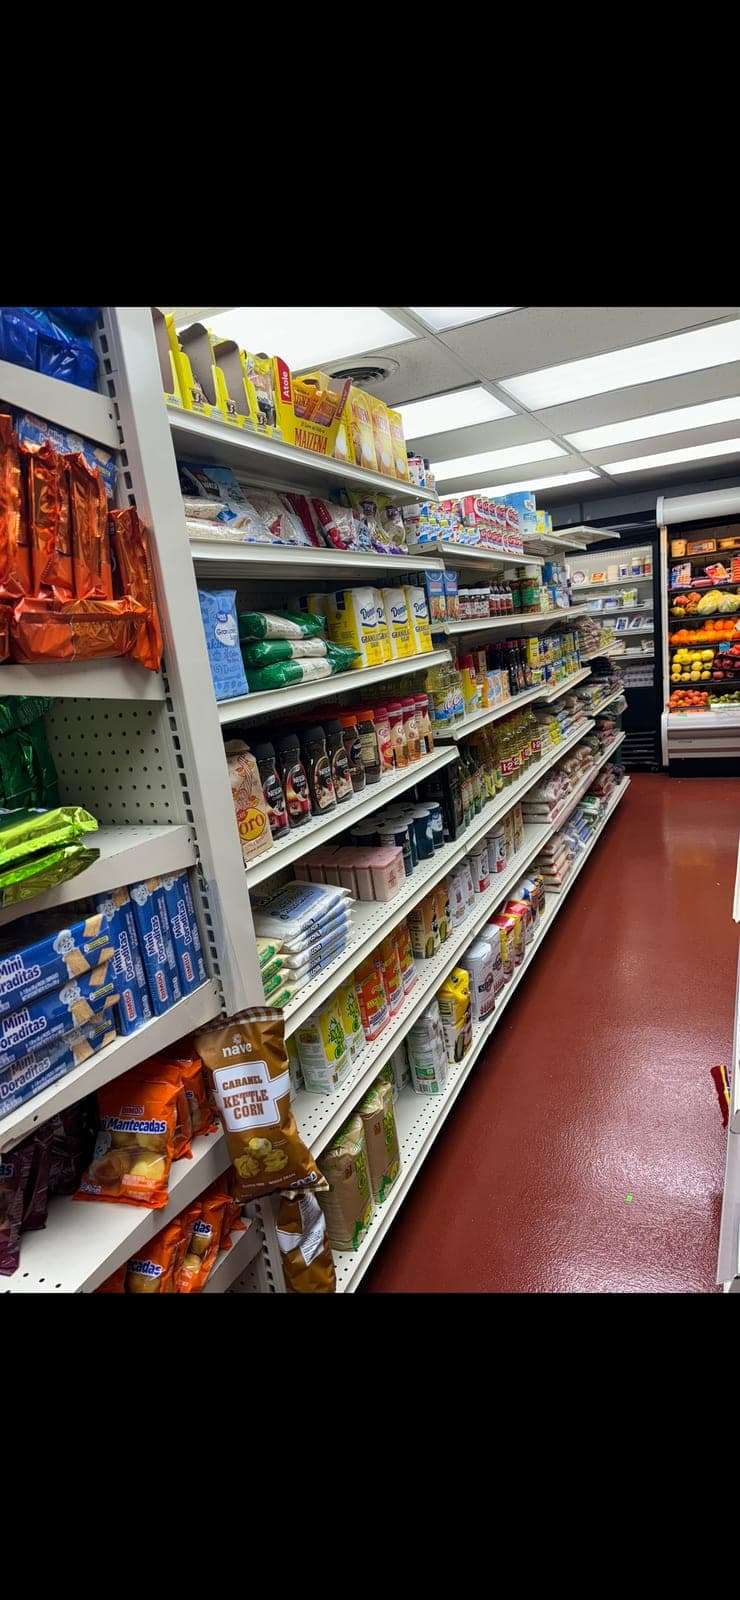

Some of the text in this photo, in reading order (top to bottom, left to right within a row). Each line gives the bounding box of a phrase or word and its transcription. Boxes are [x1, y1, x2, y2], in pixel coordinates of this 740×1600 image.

[282, 371, 290, 398] Atole
[294, 427, 328, 455] MAIZENA
[173, 916, 182, 938] Mini
[178, 901, 191, 944] Doraditas
[146, 934, 155, 955] Mini
[152, 916, 166, 962] Doraditas
[0, 956, 22, 977] Mini
[114, 951, 123, 973] Mini
[120, 932, 134, 980] Doraditas
[183, 954, 192, 980] BIMBO
[0, 966, 40, 995] raditas
[157, 973, 166, 1000] BIMBO
[125, 991, 135, 1019] BIMBO
[4, 1008, 29, 1032] Mini
[0, 1018, 45, 1048] oraditas
[222, 1043, 253, 1057] nave
[11, 1052, 35, 1075] Mini
[1, 1059, 50, 1097] Doraditas
[222, 1076, 262, 1090] CARAMEL
[223, 1090, 269, 1108] KETTLE
[234, 1103, 264, 1119] CORN
[107, 1119, 166, 1132] Mantecadas
